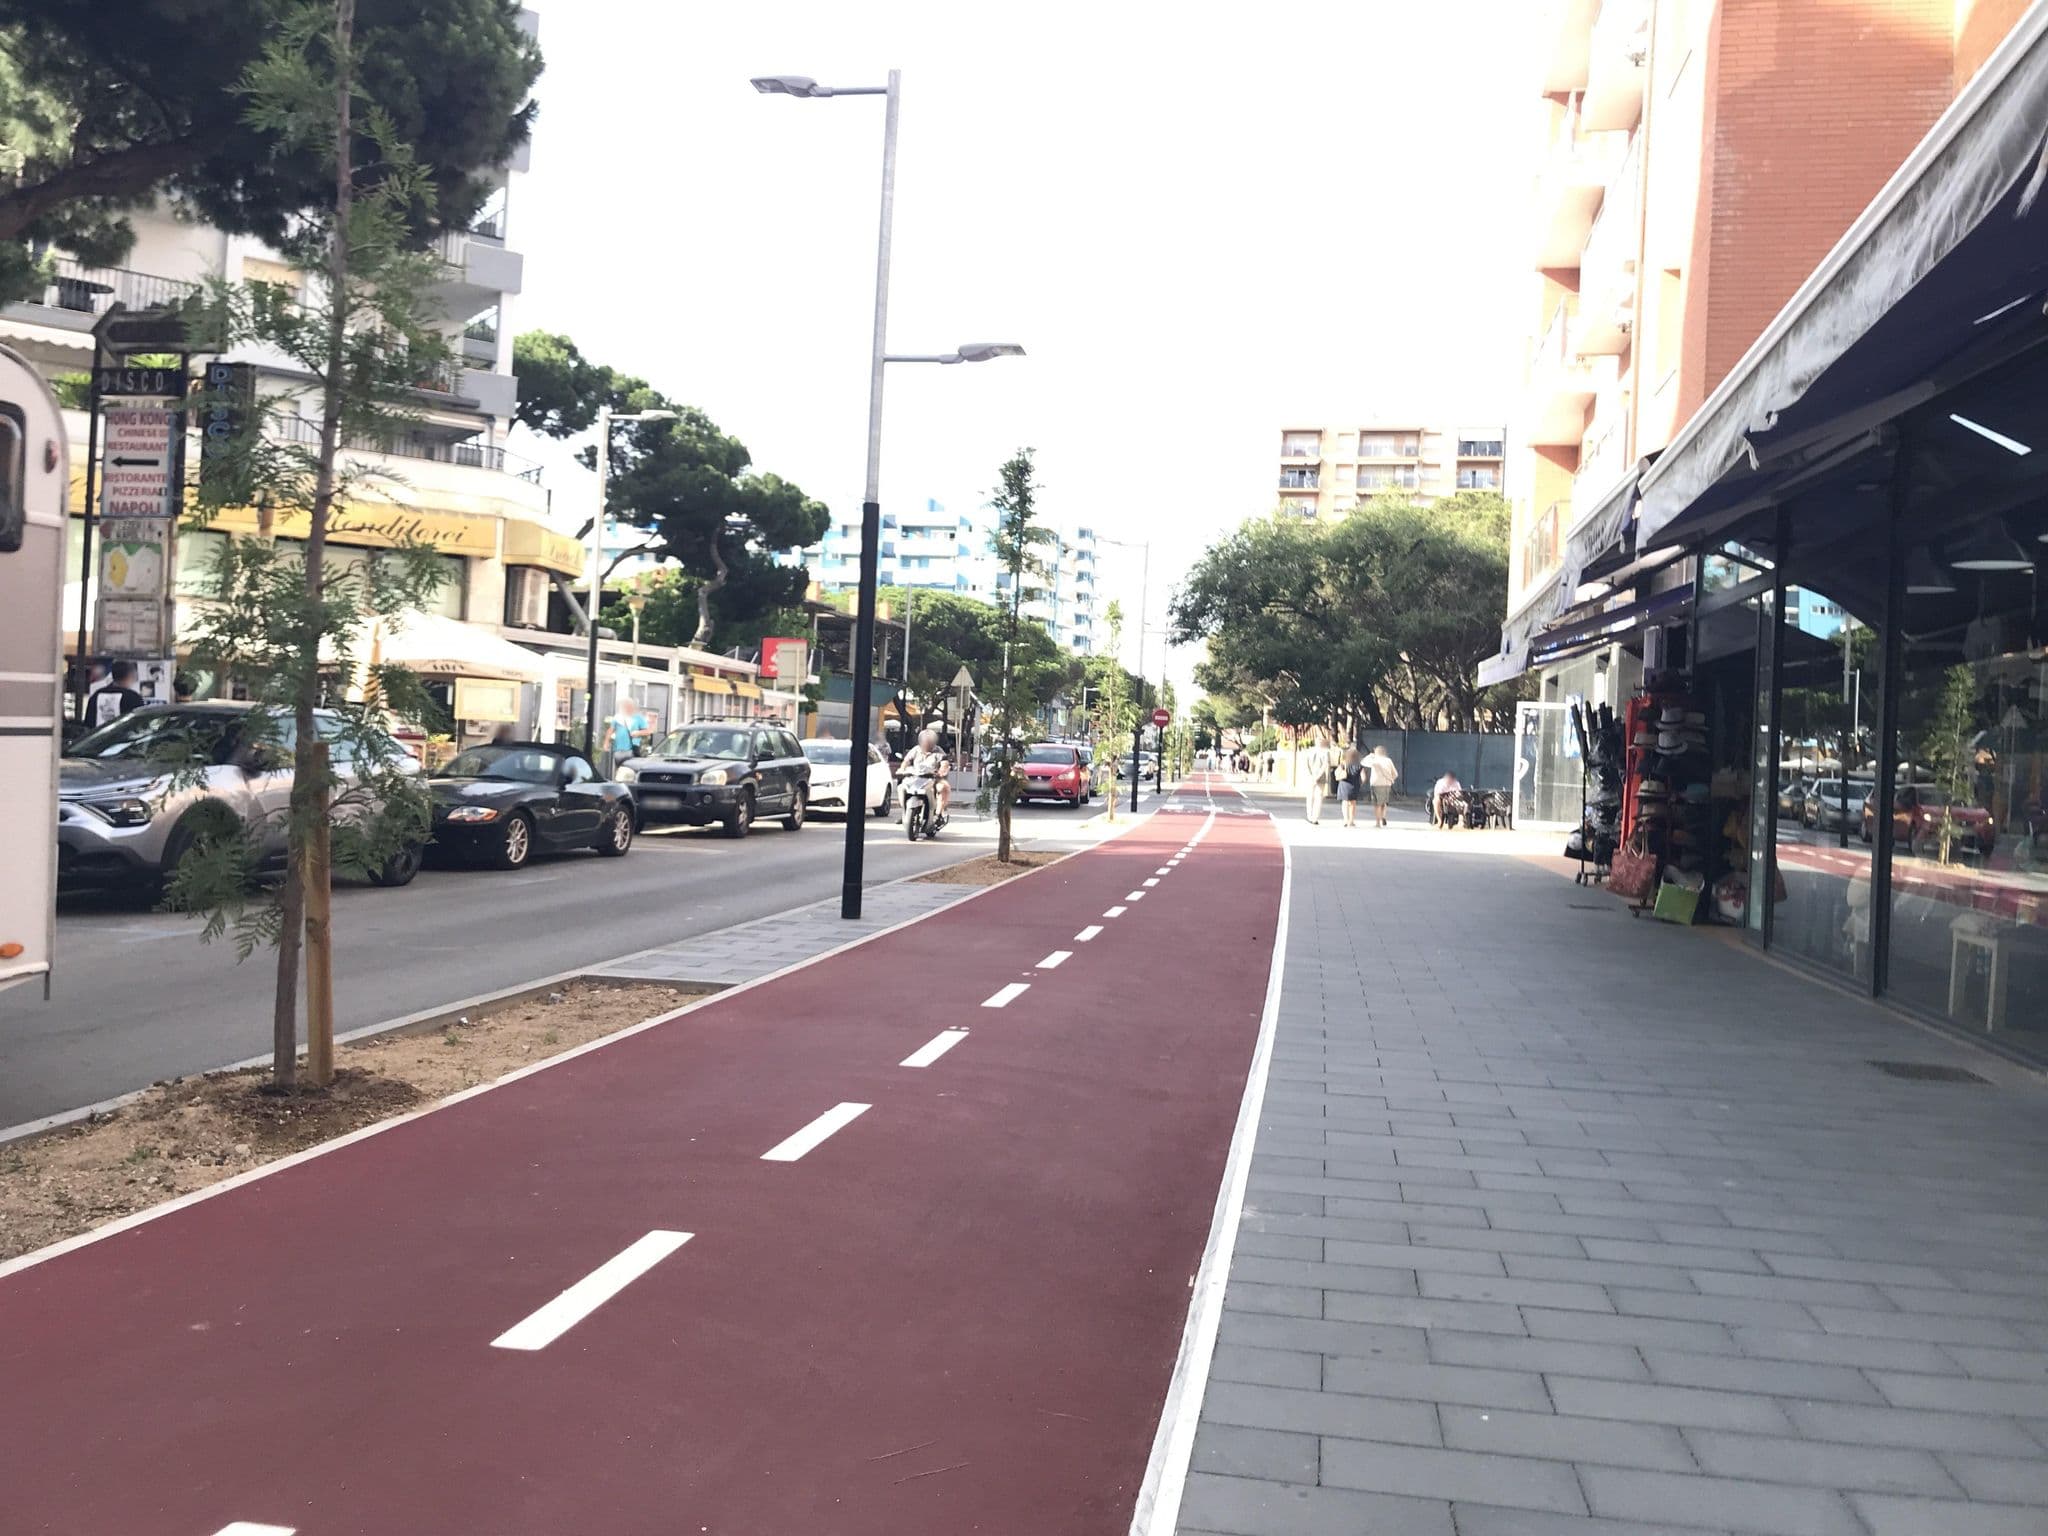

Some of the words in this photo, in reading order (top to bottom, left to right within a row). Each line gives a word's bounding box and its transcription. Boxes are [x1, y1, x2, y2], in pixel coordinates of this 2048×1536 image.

[101, 371, 164, 392] DISCO
[107, 411, 137, 425] HONG
[109, 500, 161, 514] NAPOLI
